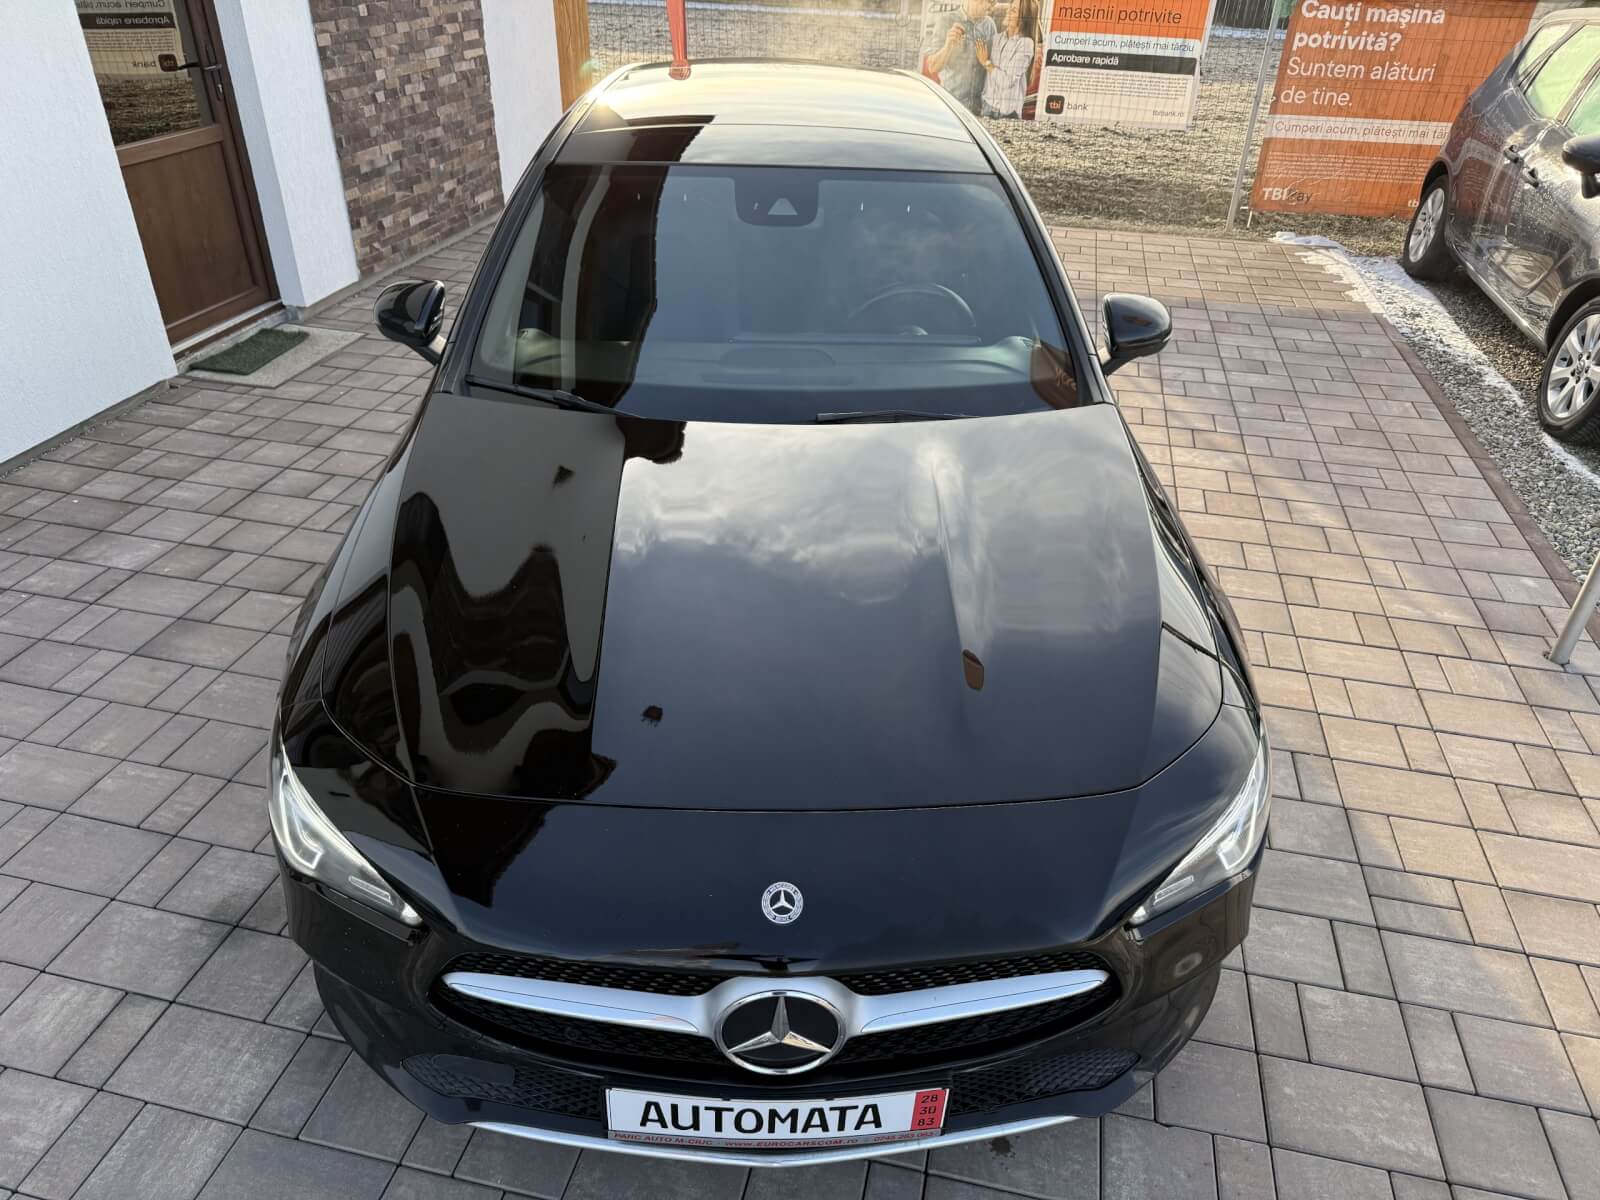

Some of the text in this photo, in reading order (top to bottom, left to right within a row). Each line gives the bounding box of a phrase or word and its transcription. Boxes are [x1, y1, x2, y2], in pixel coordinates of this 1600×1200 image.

[1117, 8, 1182, 25] potrivite
[1301, 0, 1362, 28] Cauți
[1054, 35, 1091, 47] Cumperi
[1152, 42, 1169, 50] mai
[1293, 30, 1402, 52] potrivită?
[1051, 53, 1120, 66] Aprobare rapidă
[1287, 56, 1437, 83] Suntem alături
[1280, 85, 1353, 106] de tine.
[1066, 103, 1089, 111] bank
[1275, 121, 1324, 136] Cumperi
[1408, 128, 1431, 138] mai
[1407, 199, 1420, 208] tb
[920, 1094, 938, 1104] 28
[640, 1101, 883, 1134] AUTOMATA
[917, 1117, 935, 1127] 83
[644, 1135, 673, 1143] AUTO
